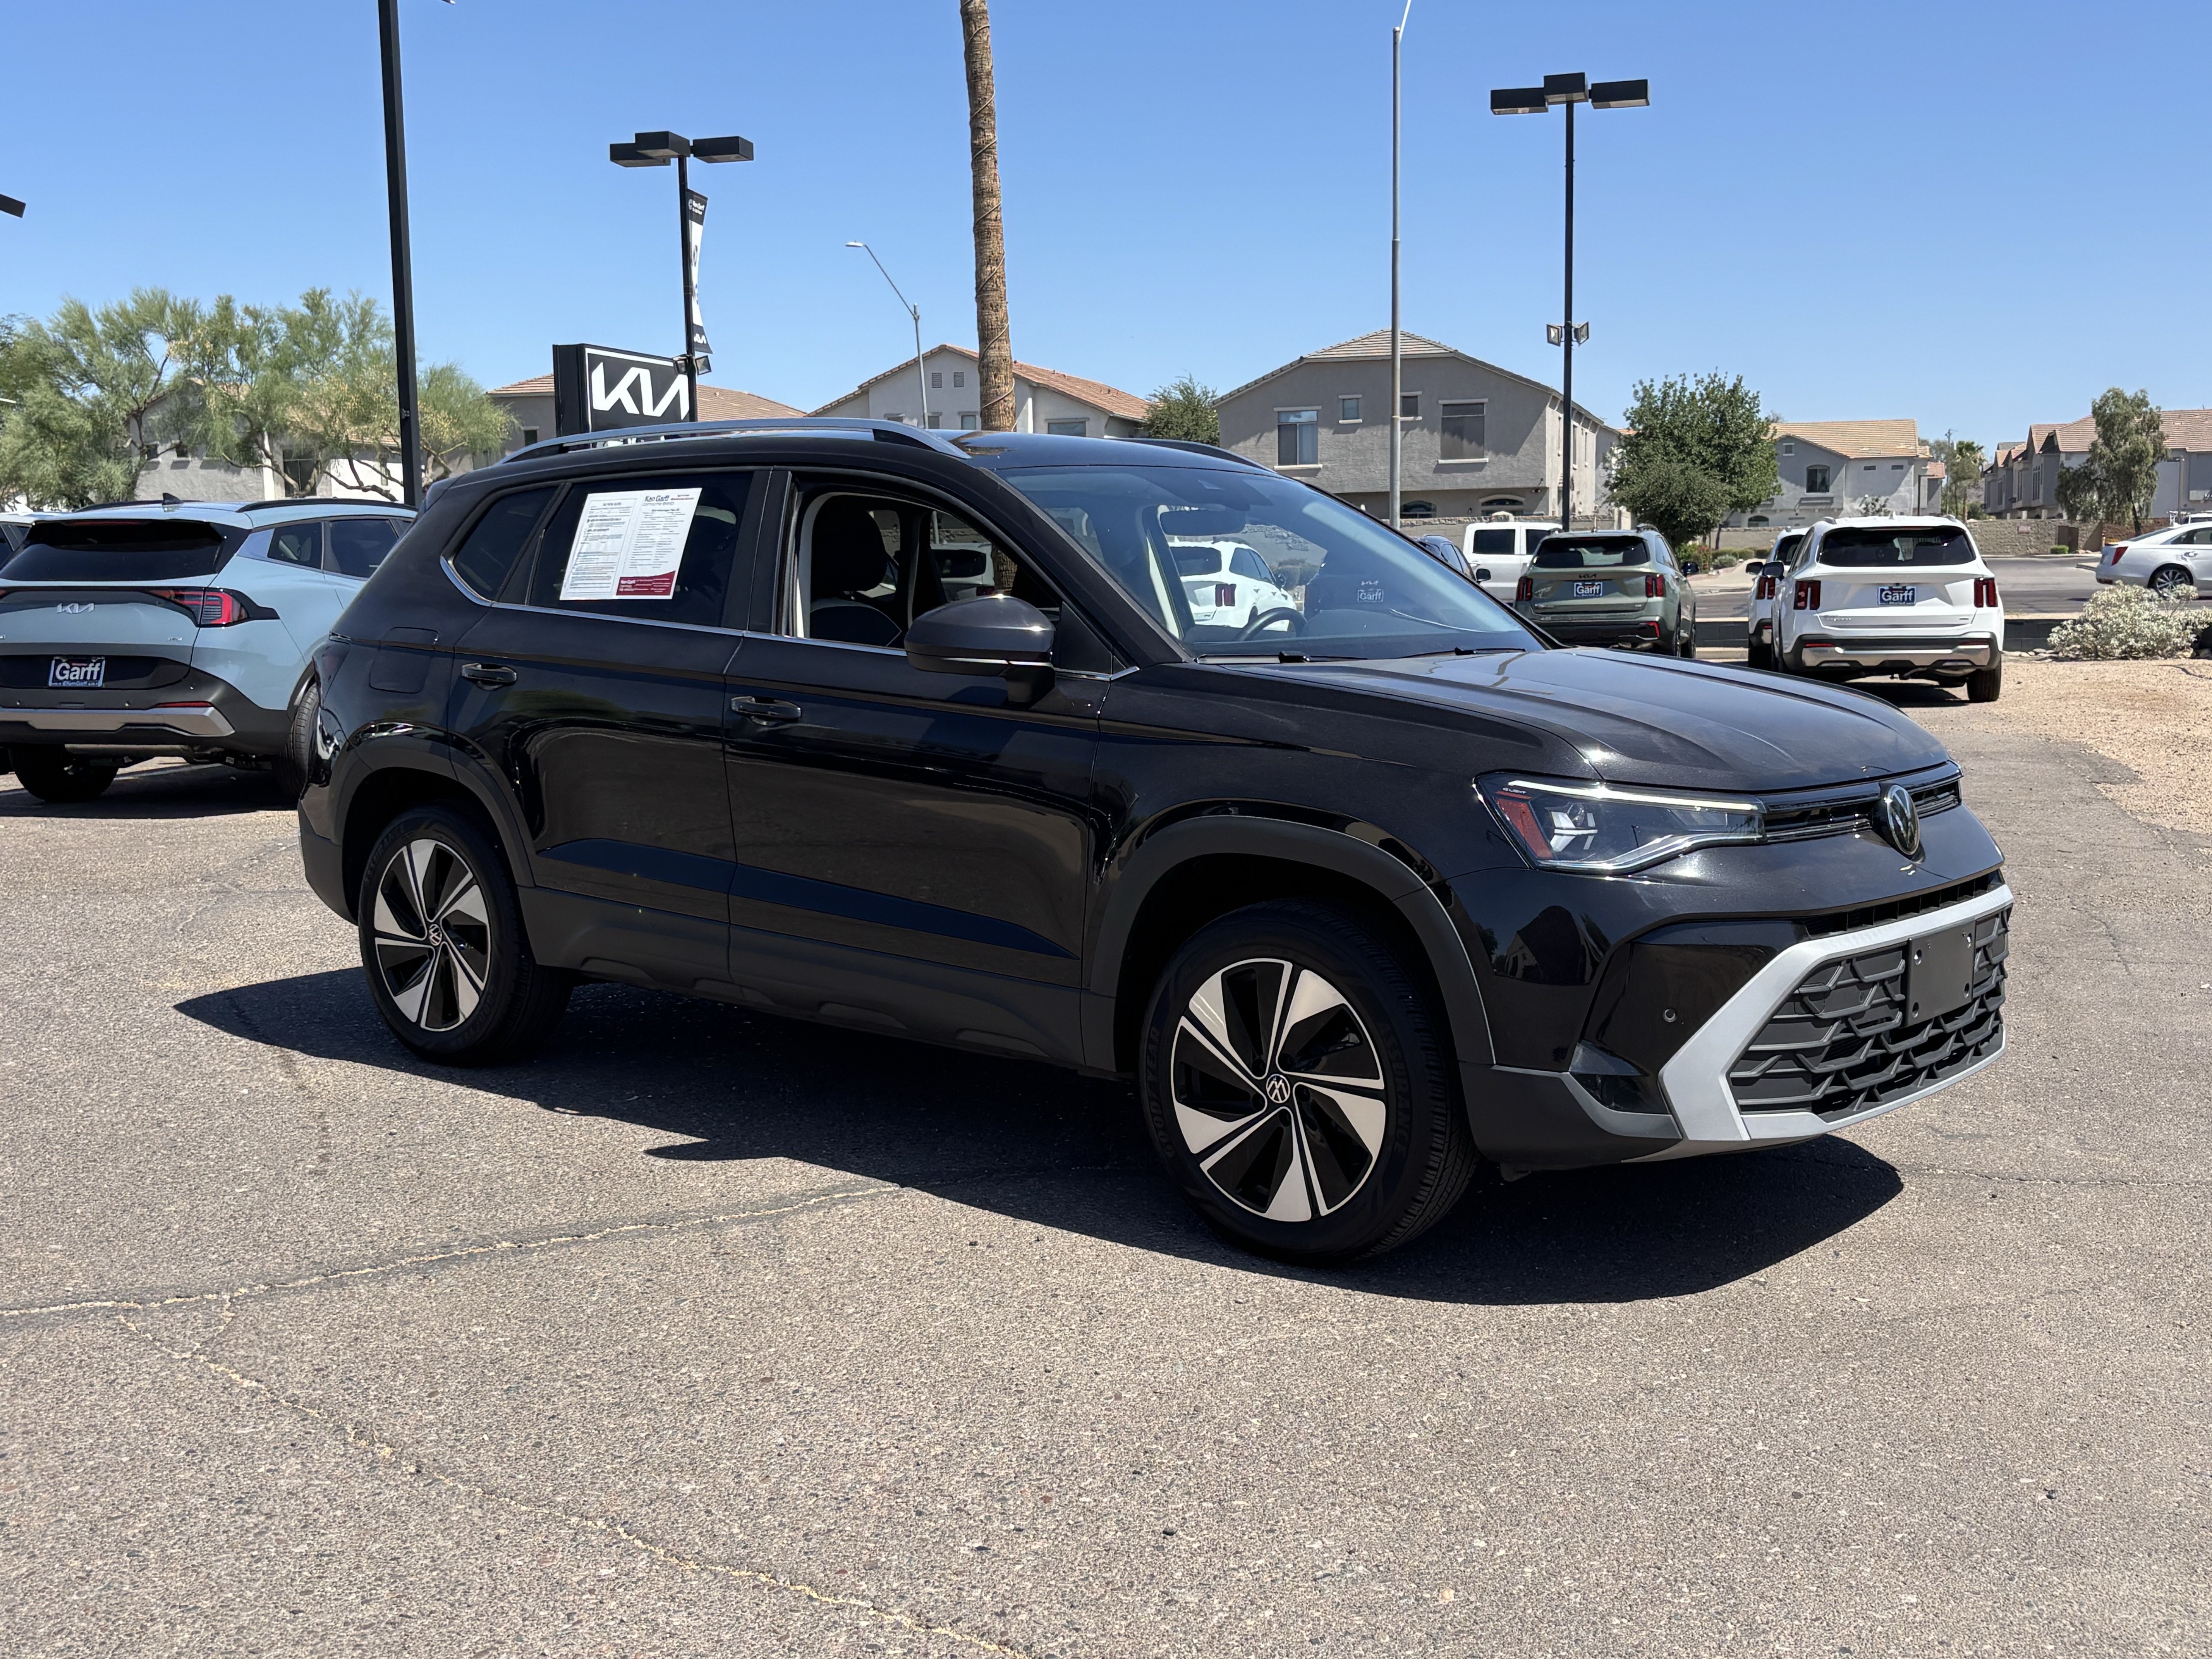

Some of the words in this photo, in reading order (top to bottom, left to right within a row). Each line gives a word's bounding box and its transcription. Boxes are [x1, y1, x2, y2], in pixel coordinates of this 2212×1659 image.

[591, 362, 689, 420] KIA
[1577, 585, 1600, 594] Garff
[1882, 591, 1913, 601] Garff
[56, 603, 94, 614] KIA
[55, 663, 101, 680] Garff
[1147, 1026, 1176, 1158] GOODYEAR
[1378, 1023, 1411, 1156] ASSURANCE
